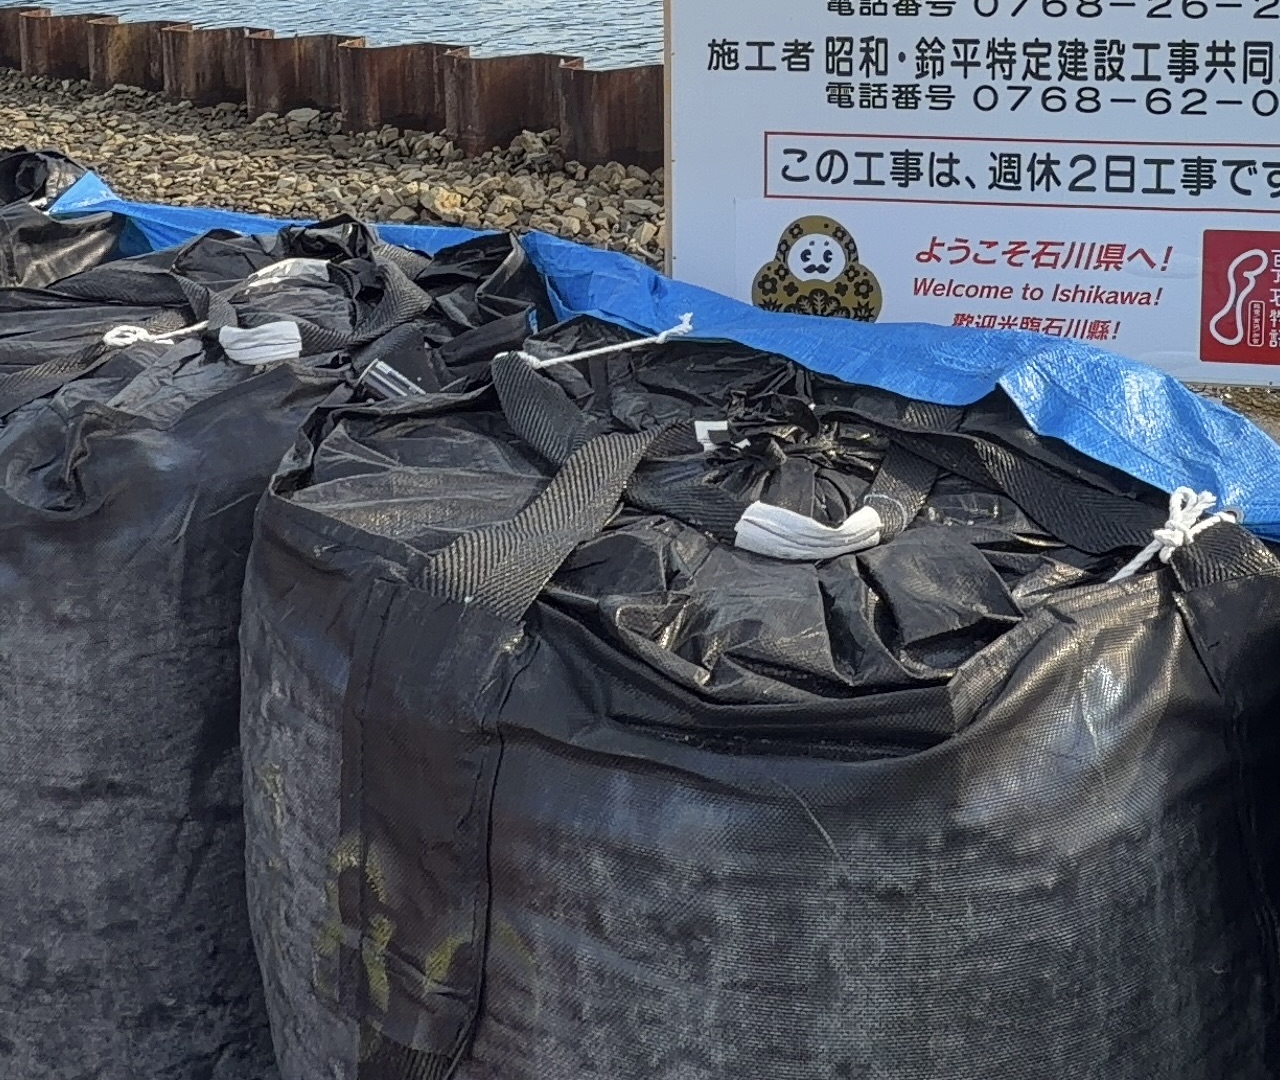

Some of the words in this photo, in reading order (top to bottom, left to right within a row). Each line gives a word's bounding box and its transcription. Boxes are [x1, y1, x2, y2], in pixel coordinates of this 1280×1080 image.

[707, 38, 815, 72] 施工者
[825, 81, 956, 111] 電話番号
[915, 236, 1174, 272] ようこそ石川県へ!
[913, 277, 1014, 300] Welcome
[1021, 282, 1044, 301] to
[1051, 283, 1163, 306] Ishikawa!
